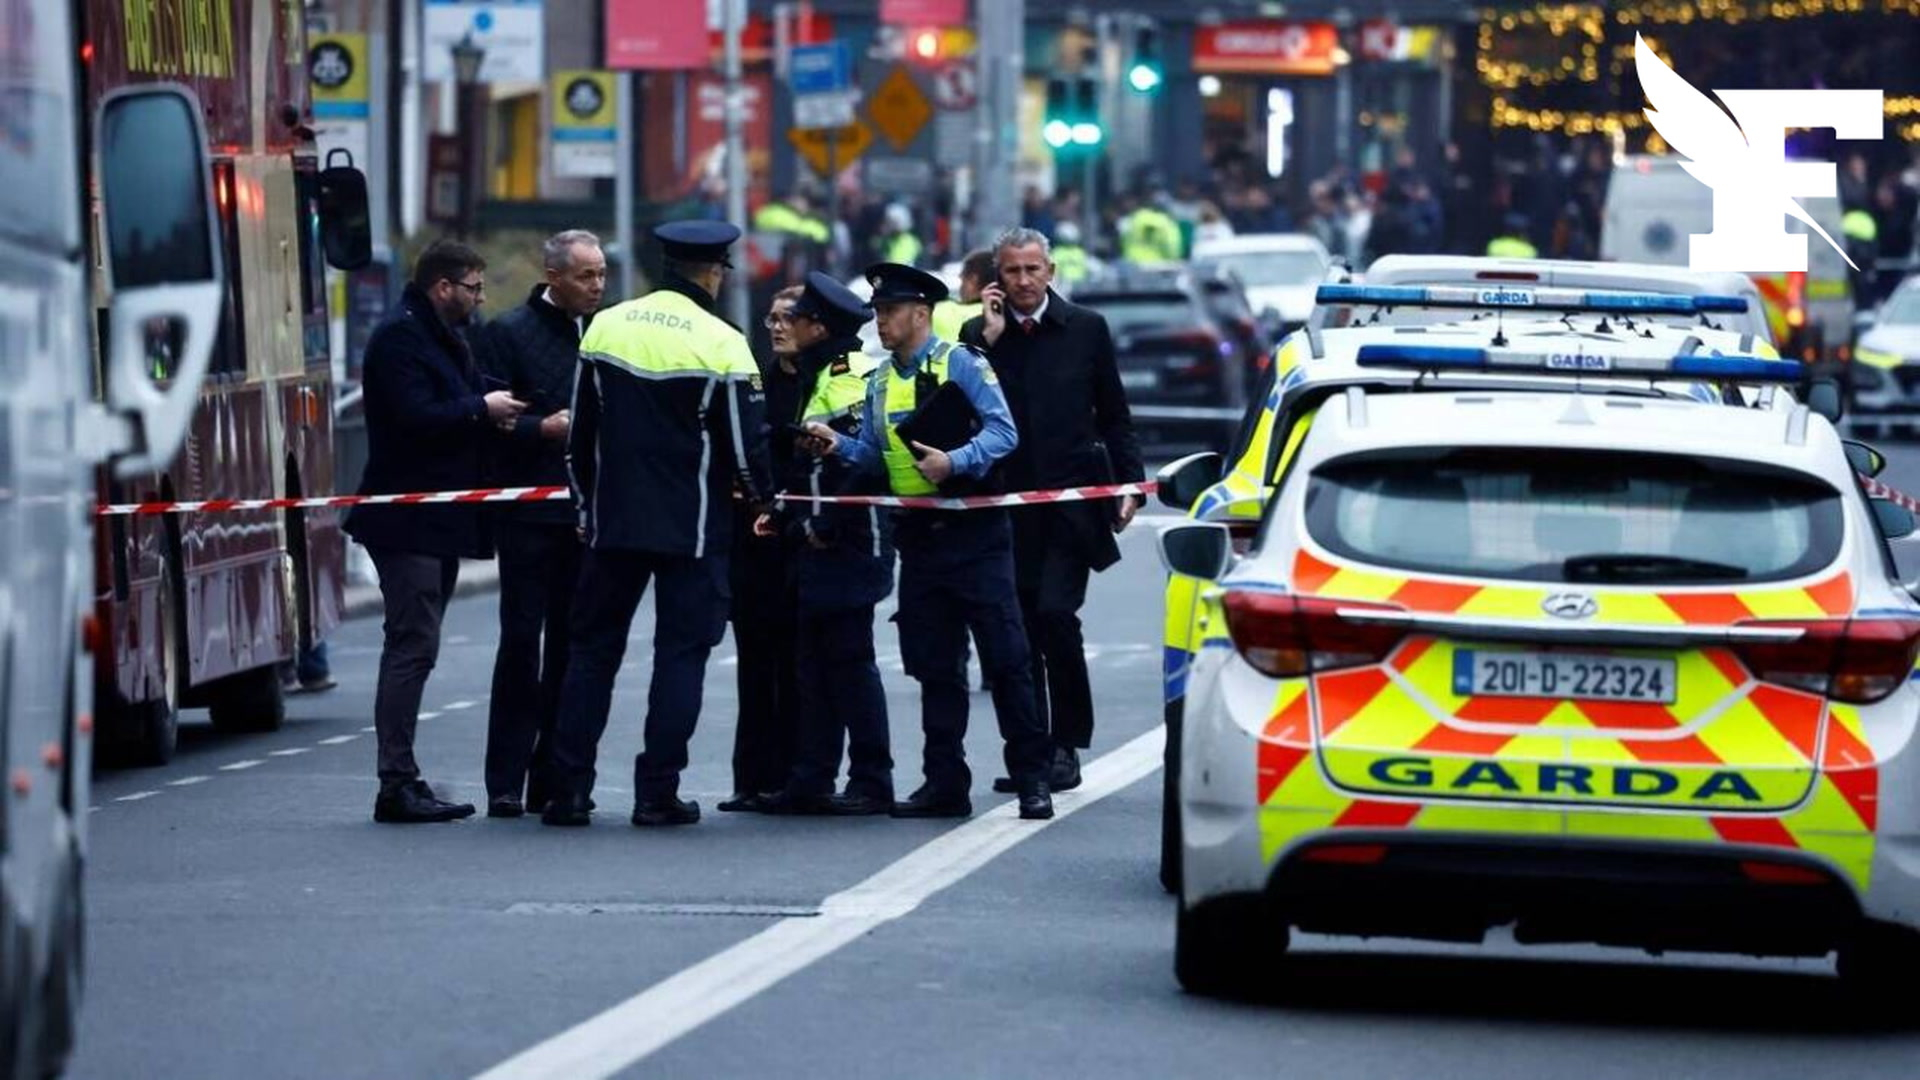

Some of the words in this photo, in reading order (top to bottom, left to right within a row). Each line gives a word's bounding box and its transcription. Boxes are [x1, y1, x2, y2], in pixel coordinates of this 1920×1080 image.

[1482, 291, 1529, 305] GARDA
[625, 309, 694, 332] GARDA
[1551, 353, 1606, 369] GARDA
[1482, 660, 1665, 698] 201-D-22324
[1367, 756, 1763, 801] GARDA
